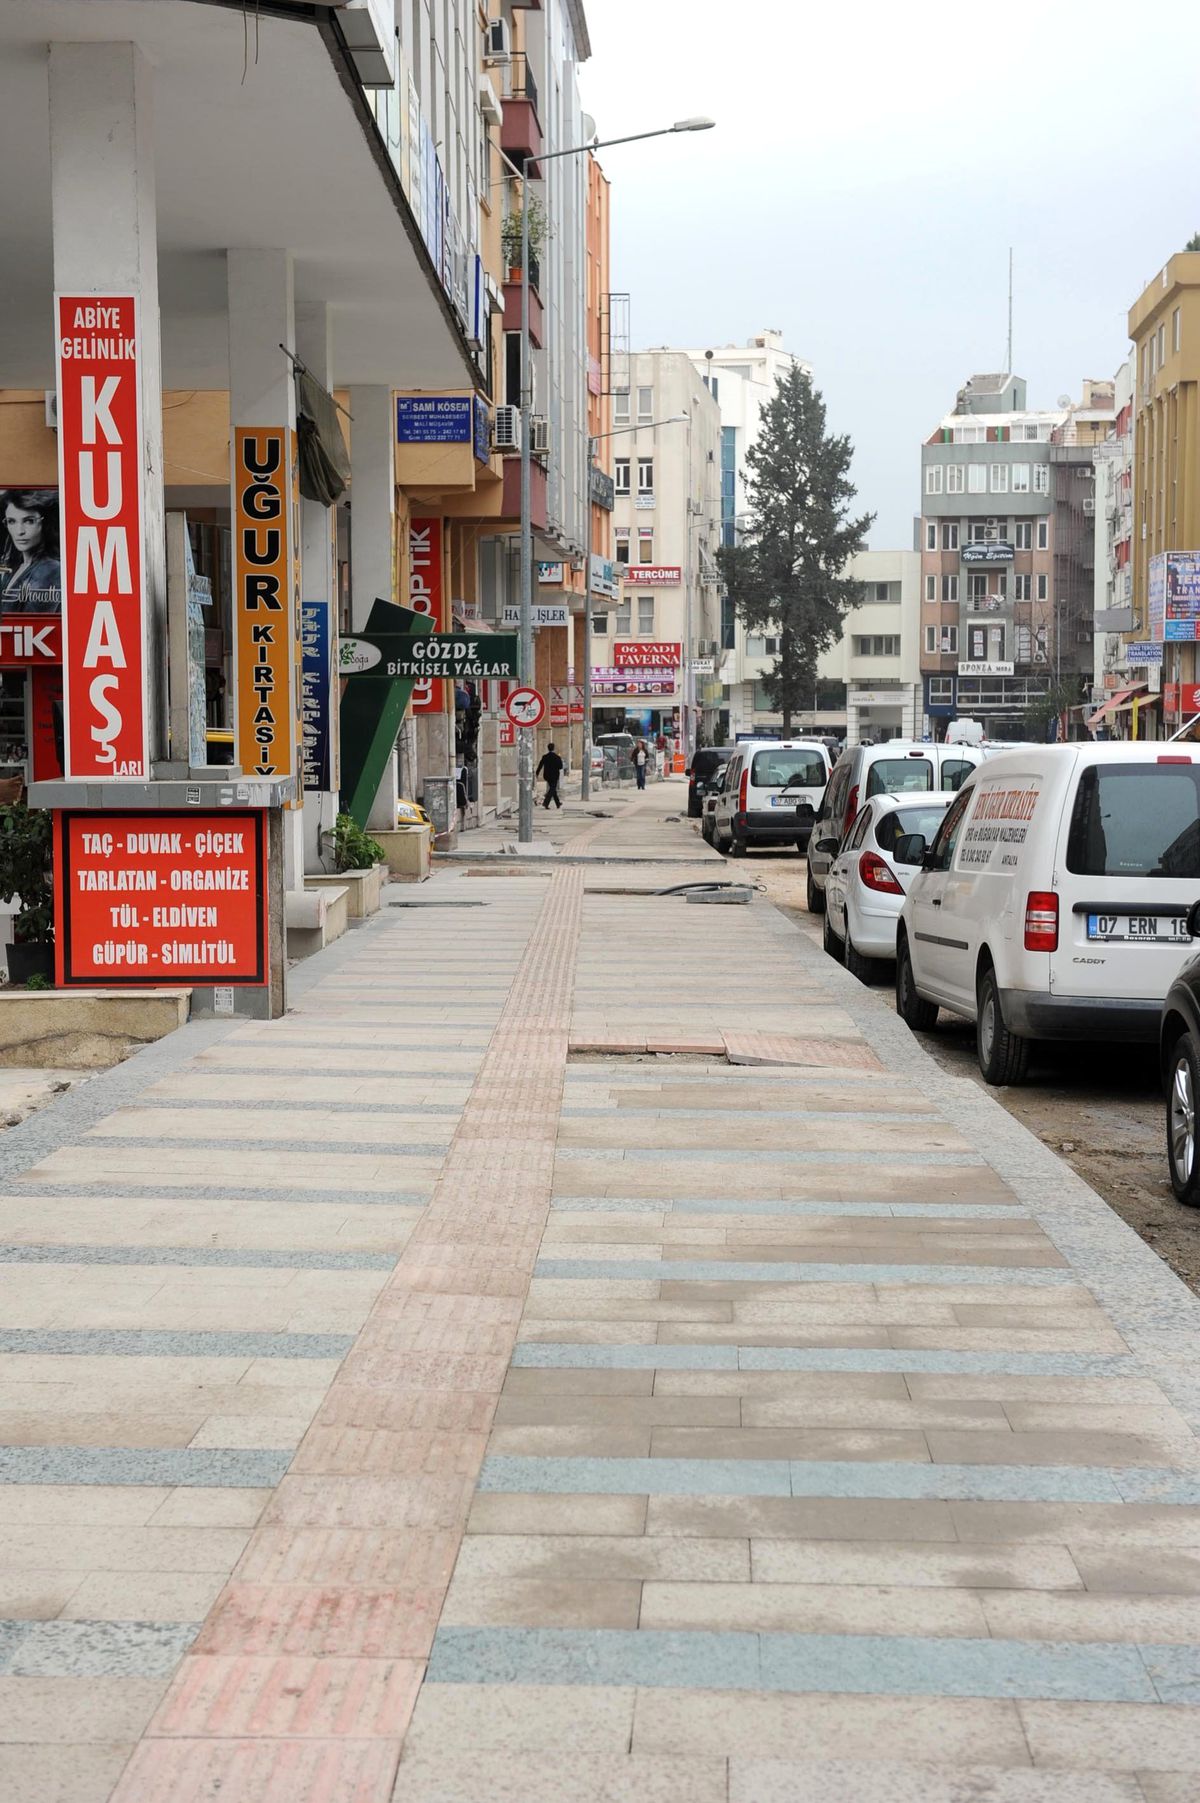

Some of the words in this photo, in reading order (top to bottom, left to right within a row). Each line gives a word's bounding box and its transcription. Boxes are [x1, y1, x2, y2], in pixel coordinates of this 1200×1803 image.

[73, 302, 120, 329] ABİYE
[60, 332, 137, 360] GELİNLİK
[412, 401, 435, 412] SAMİ
[242, 436, 283, 611] UĞUR
[73, 375, 133, 764] KUMAŞ
[2, 583, 60, 602] Silhouette
[412, 637, 479, 659] GÖZDE
[641, 645, 675, 653] VADİ
[387, 658, 450, 676] BİTKİSEL
[454, 659, 510, 676] YAĞLAR
[616, 654, 680, 665] TAVERNA
[112, 761, 142, 776] LARI
[82, 833, 113, 858] TAÇ
[127, 833, 182, 854] DUVAK
[195, 830, 244, 858] ÇİÇEK
[77, 870, 157, 891] TARLATAN
[170, 867, 249, 891] ORGANİZE
[110, 904, 139, 928] TÜL
[153, 904, 218, 928] ELDİVEN
[1099, 917, 1118, 934] 07
[1128, 917, 1158, 935] ERN
[92, 940, 148, 965] GÜPÜR
[161, 940, 236, 965] SİMLİTÜL
[1072, 957, 1107, 965] CADDY
